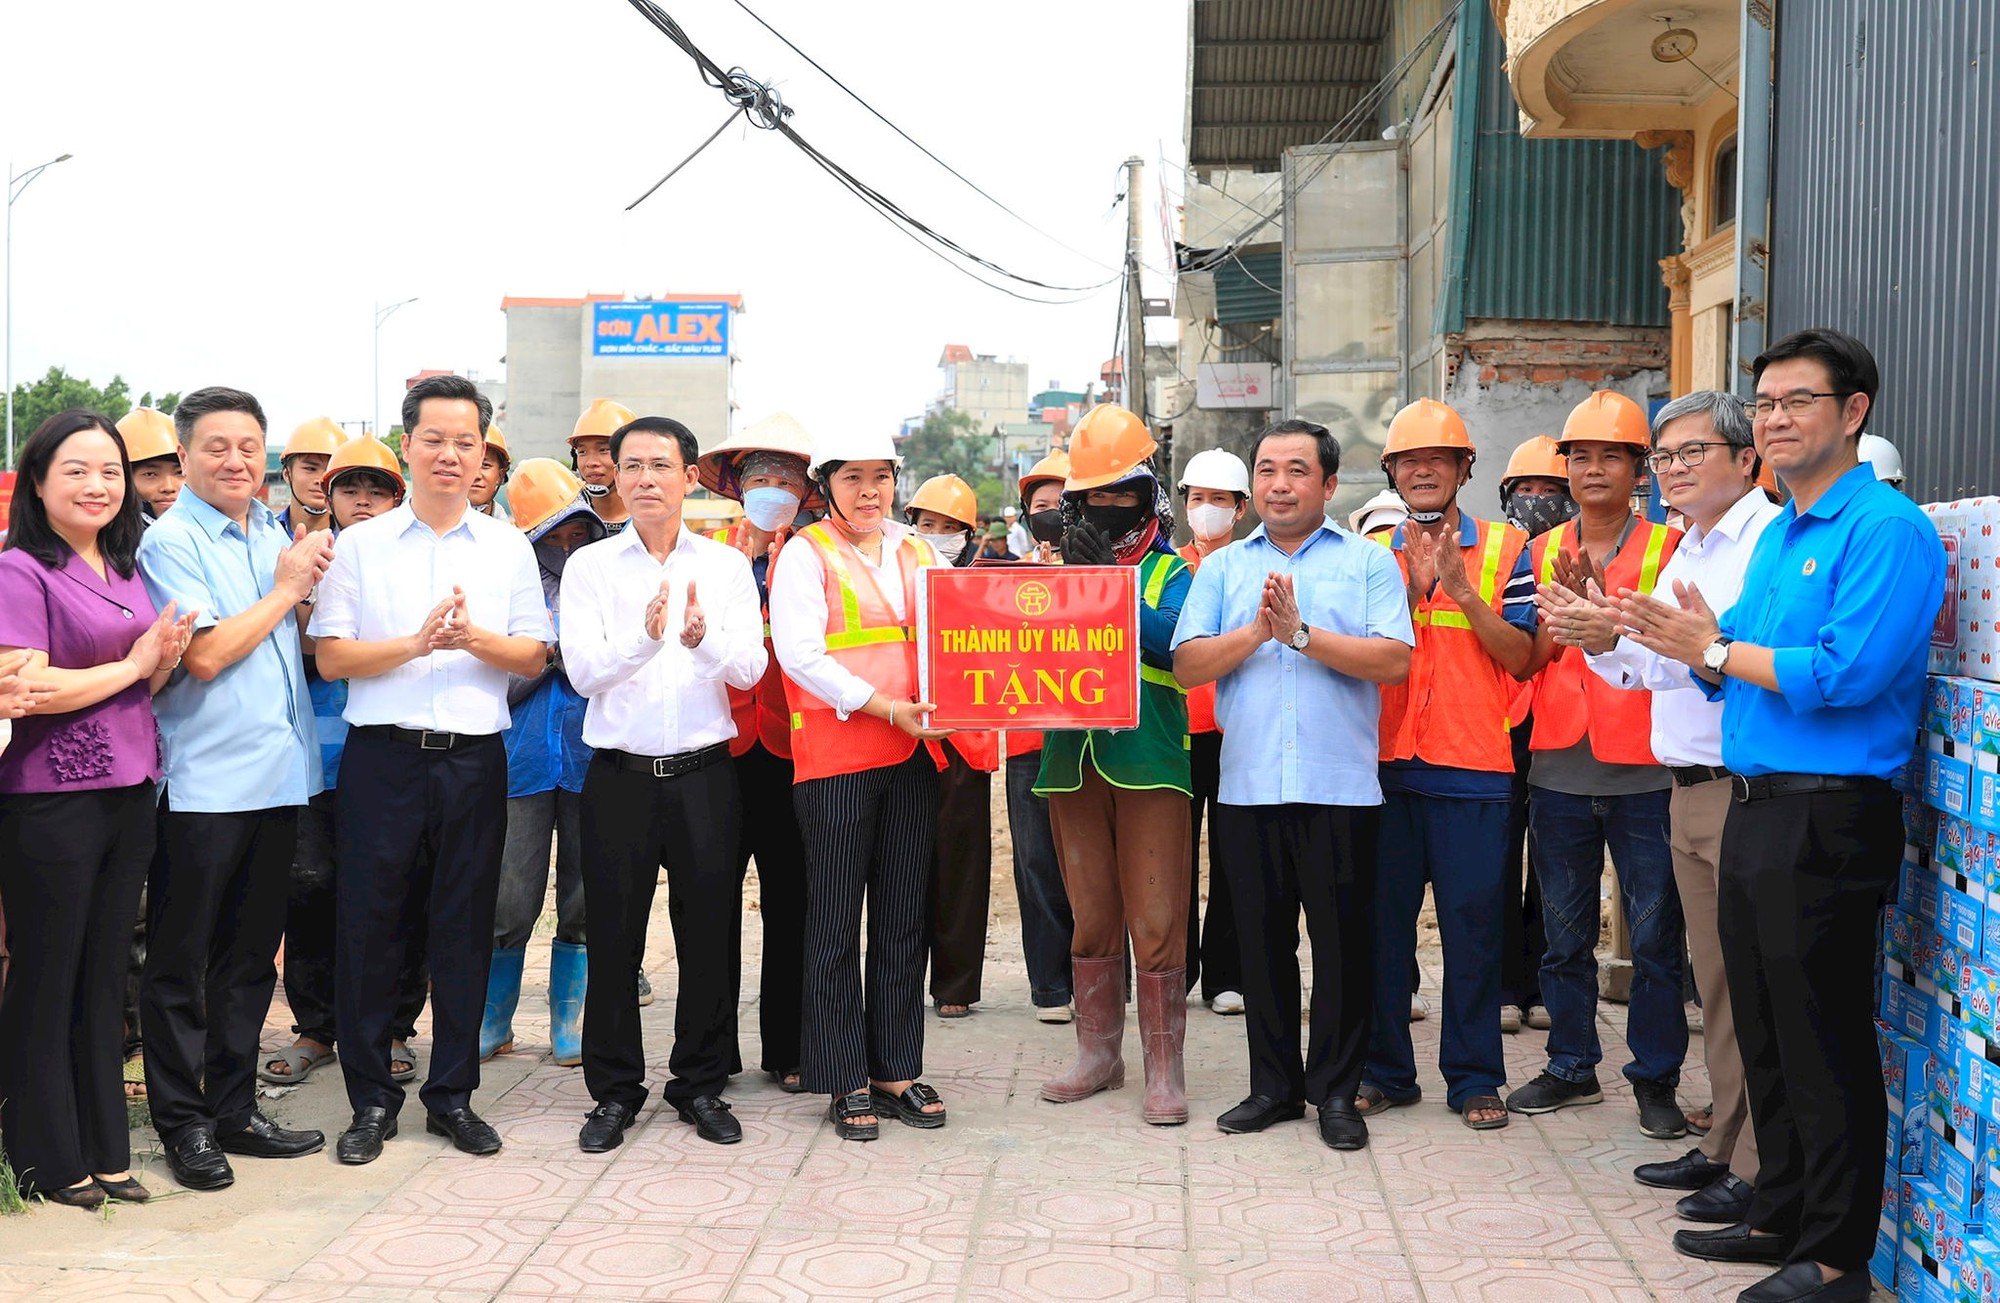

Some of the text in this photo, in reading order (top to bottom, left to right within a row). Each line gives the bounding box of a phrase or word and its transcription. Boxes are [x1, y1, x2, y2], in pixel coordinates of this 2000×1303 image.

[634, 314, 723, 342] ALEX
[940, 621, 1124, 656] THÀNH ỦY HÀ NỘI
[963, 663, 1107, 716] TẶNG
